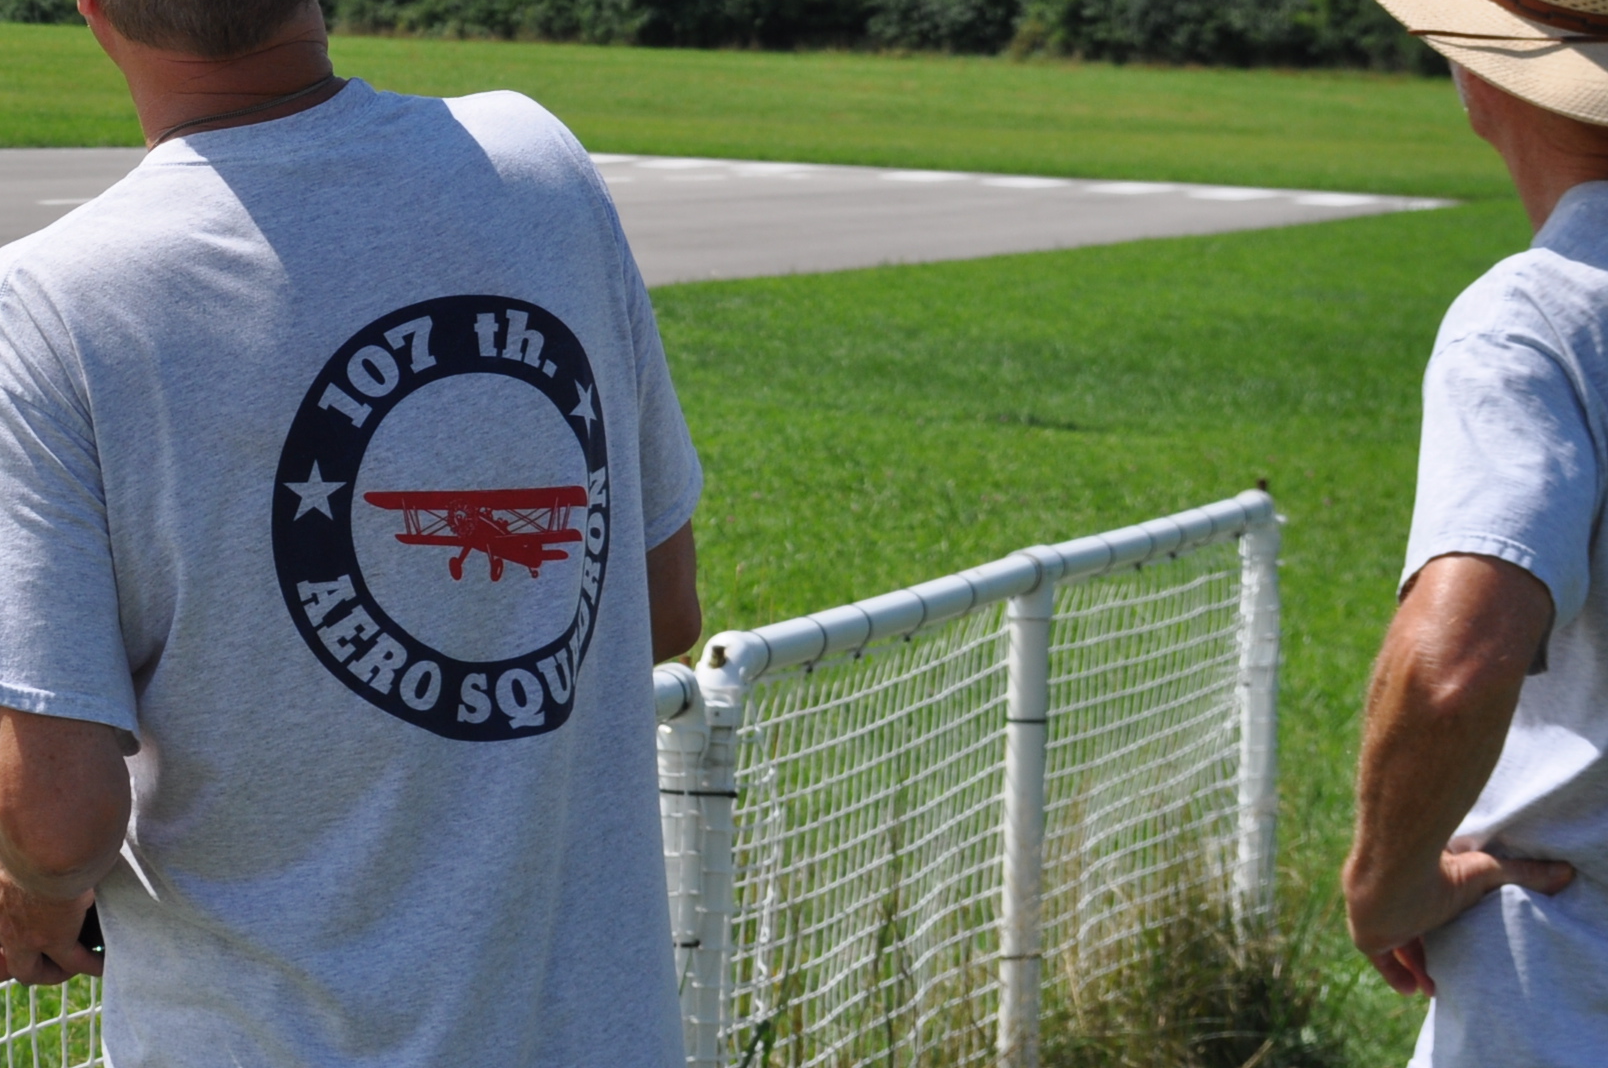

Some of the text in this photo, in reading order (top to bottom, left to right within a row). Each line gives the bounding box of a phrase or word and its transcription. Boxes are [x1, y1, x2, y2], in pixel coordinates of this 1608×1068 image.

[318, 309, 558, 429] 107 th.
[297, 575, 442, 711] AERO
